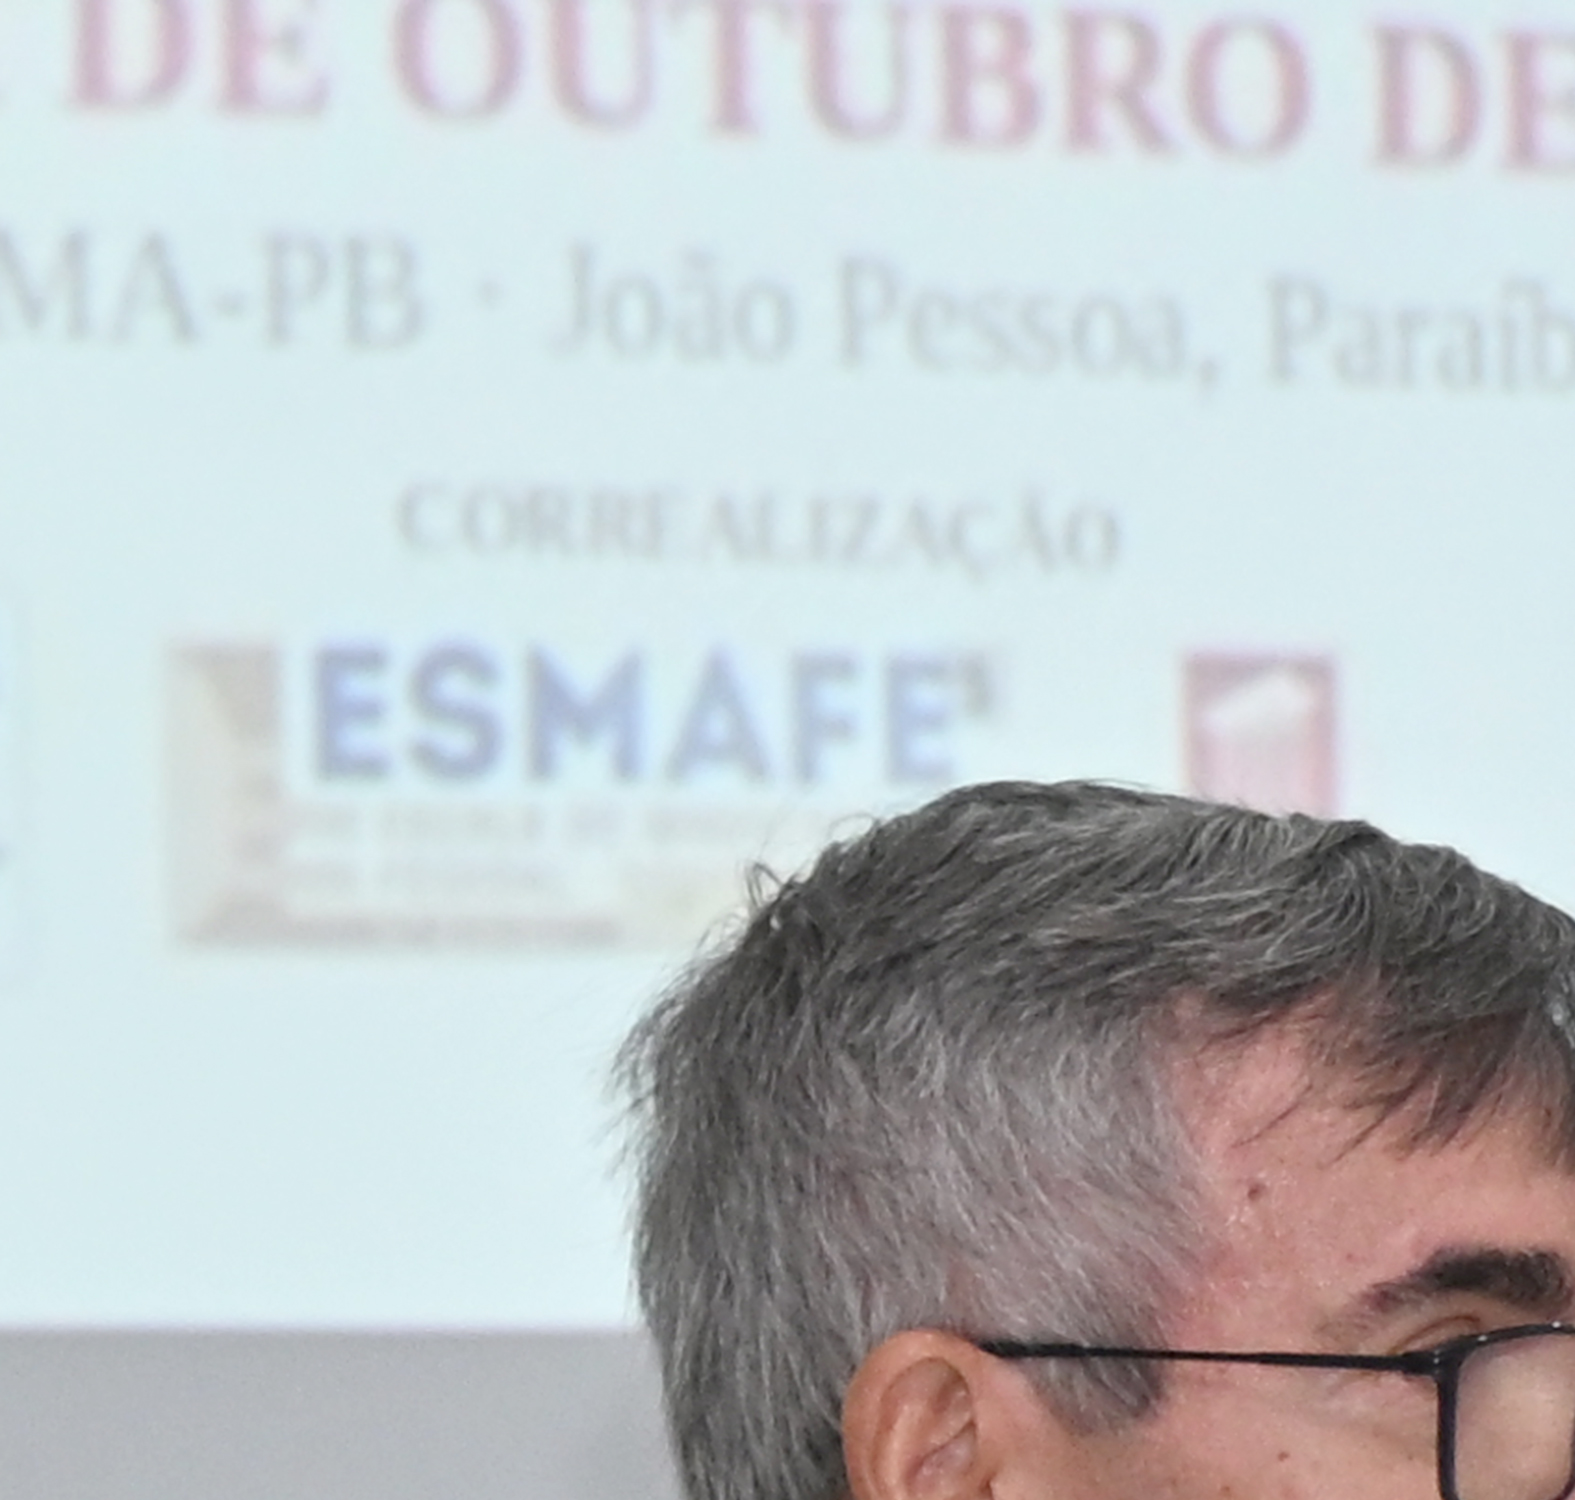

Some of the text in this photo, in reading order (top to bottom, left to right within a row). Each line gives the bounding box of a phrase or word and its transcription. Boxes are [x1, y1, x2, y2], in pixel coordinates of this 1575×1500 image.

[64, 0, 331, 120] DE
[386, 0, 1313, 163] OUTUBRO
[546, 238, 800, 365] João
[836, 252, 1226, 391] Pessoa,
[390, 473, 1130, 586] CORREALIZAÇÃO
